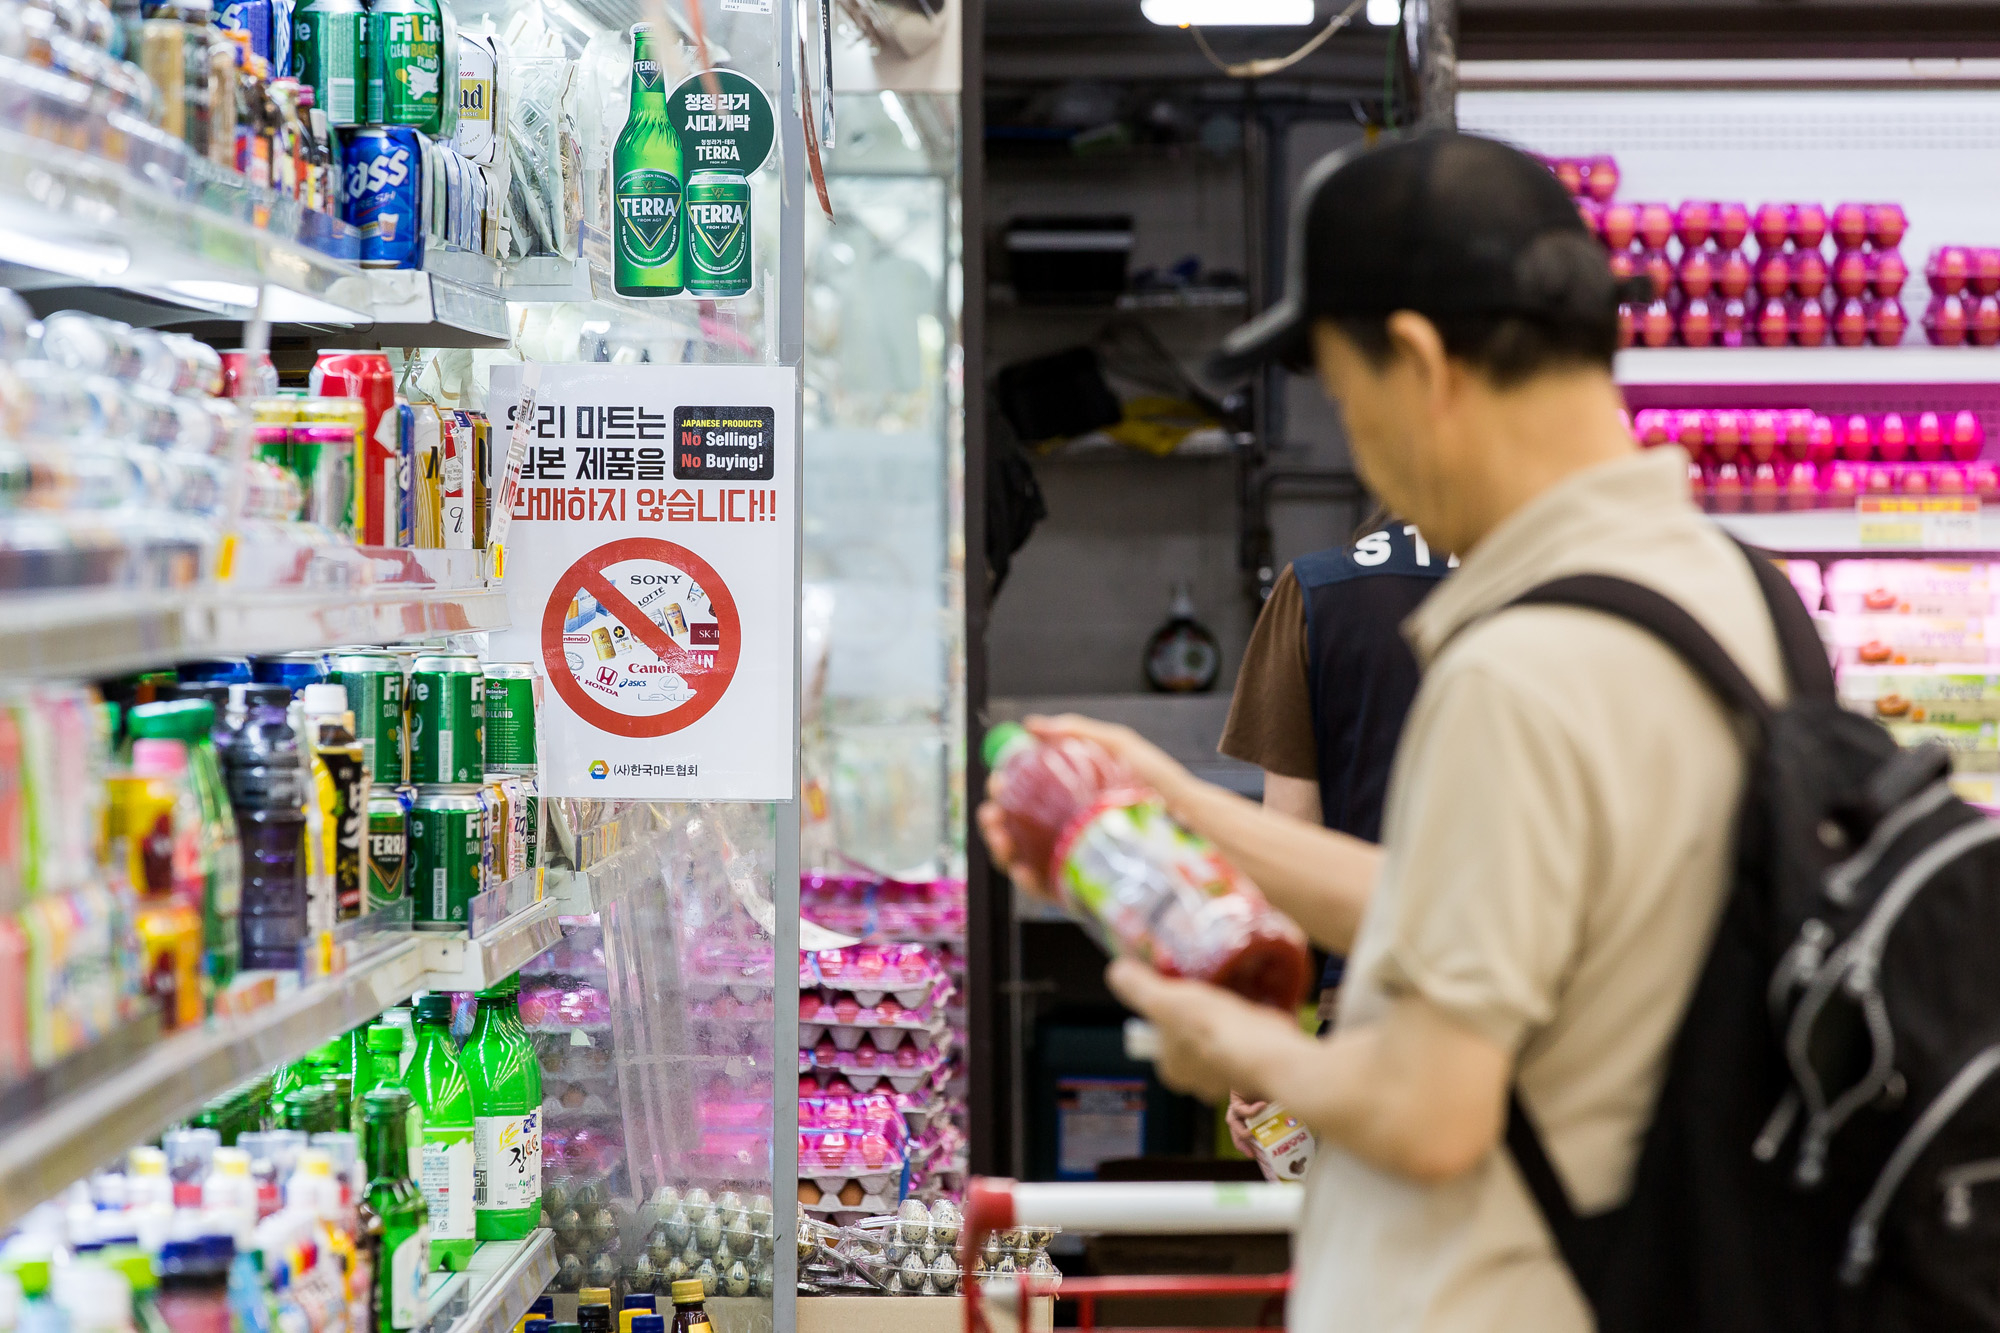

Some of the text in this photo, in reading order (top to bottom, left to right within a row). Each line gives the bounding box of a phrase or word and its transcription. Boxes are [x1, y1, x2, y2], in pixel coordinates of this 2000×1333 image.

[634, 60, 662, 73] TERRA
[696, 146, 740, 162] TERRA
[347, 149, 410, 199] ass
[620, 198, 676, 218] TERRA
[690, 204, 744, 225] TERRA
[576, 406, 666, 439] 마트는
[682, 420, 762, 428] JAPANESE PRODUCTS
[682, 432, 763, 449] No Selling!
[576, 447, 666, 480] 제품을
[682, 454, 764, 471] No Buying!
[636, 488, 776, 522] 않습니다!!
[1353, 524, 1460, 568] ST
[630, 575, 682, 585] SONY
[638, 587, 664, 606] LOTTE
[584, 680, 619, 697] HONDA
[614, 764, 698, 776] (사)한국마트협회
